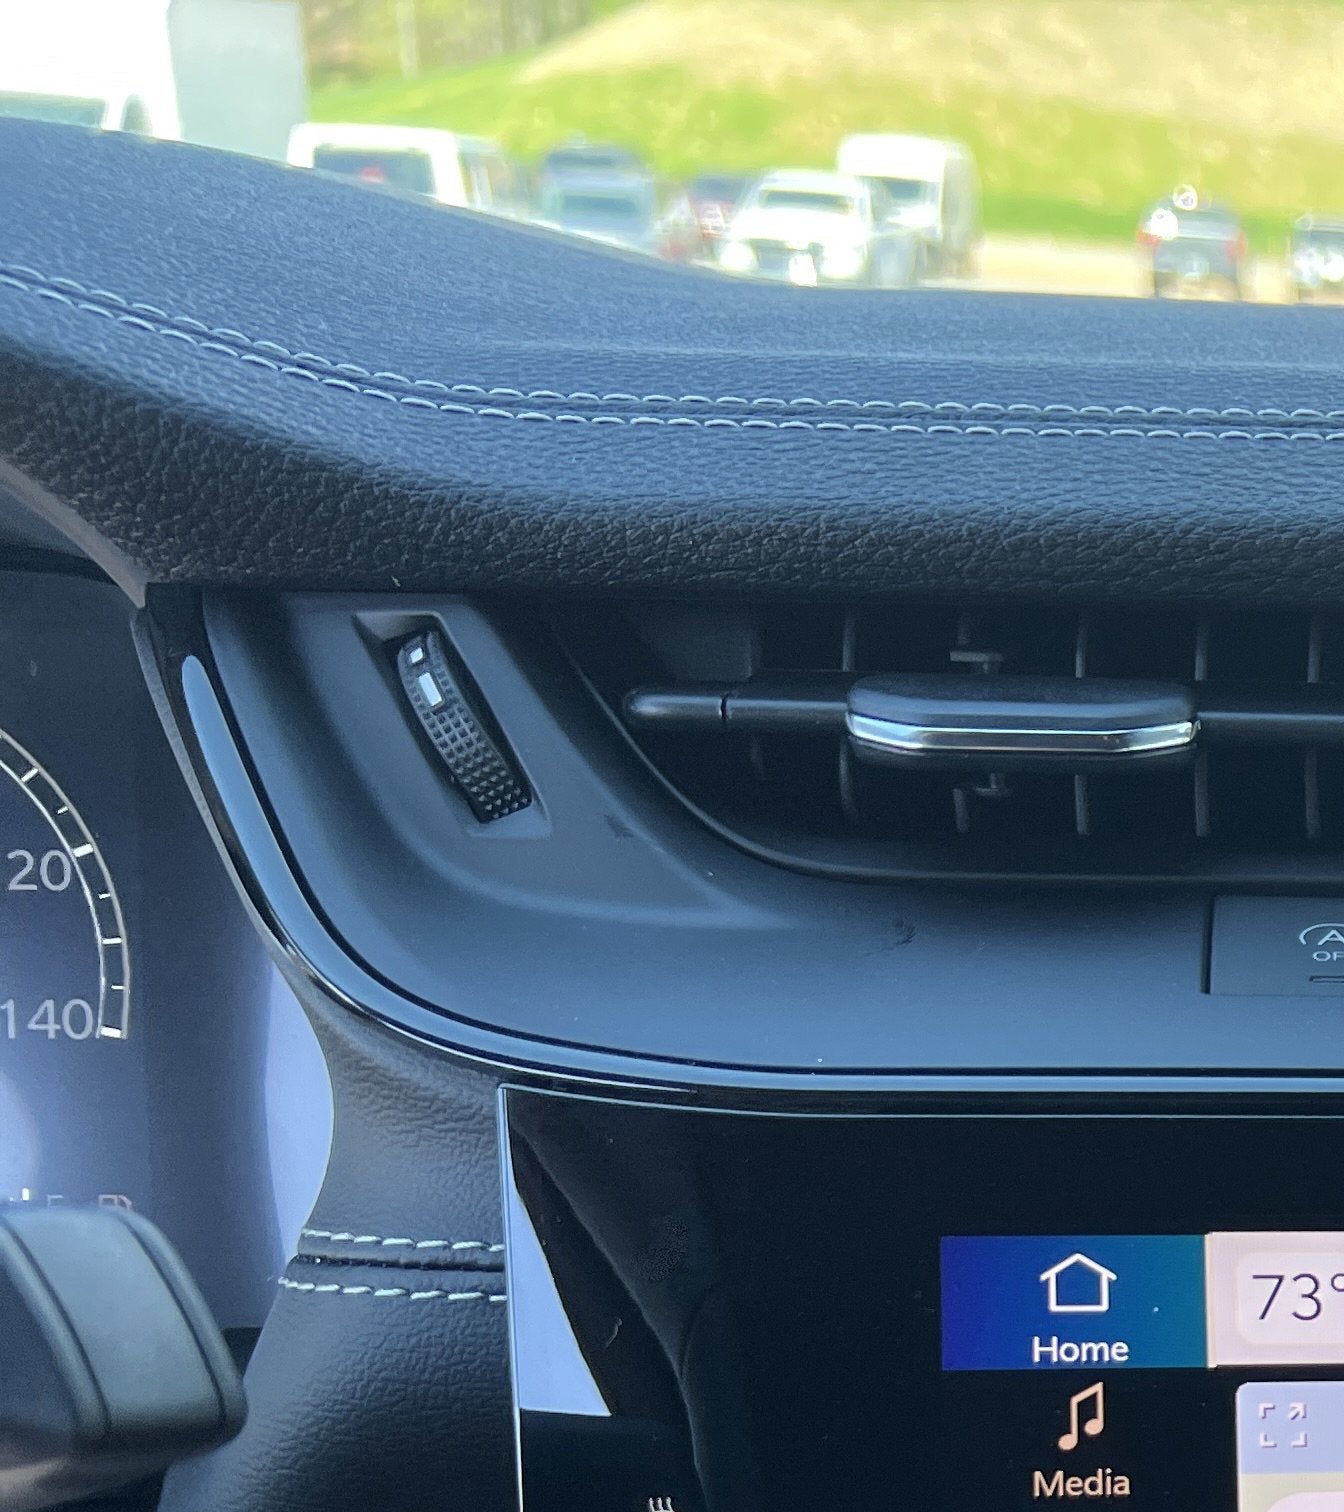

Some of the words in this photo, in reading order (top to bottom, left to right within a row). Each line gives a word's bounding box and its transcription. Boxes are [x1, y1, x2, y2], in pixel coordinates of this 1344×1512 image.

[0, 998, 94, 1041] 140
[1031, 1336, 1130, 1364] Home
[1032, 1468, 1131, 1498] Media
